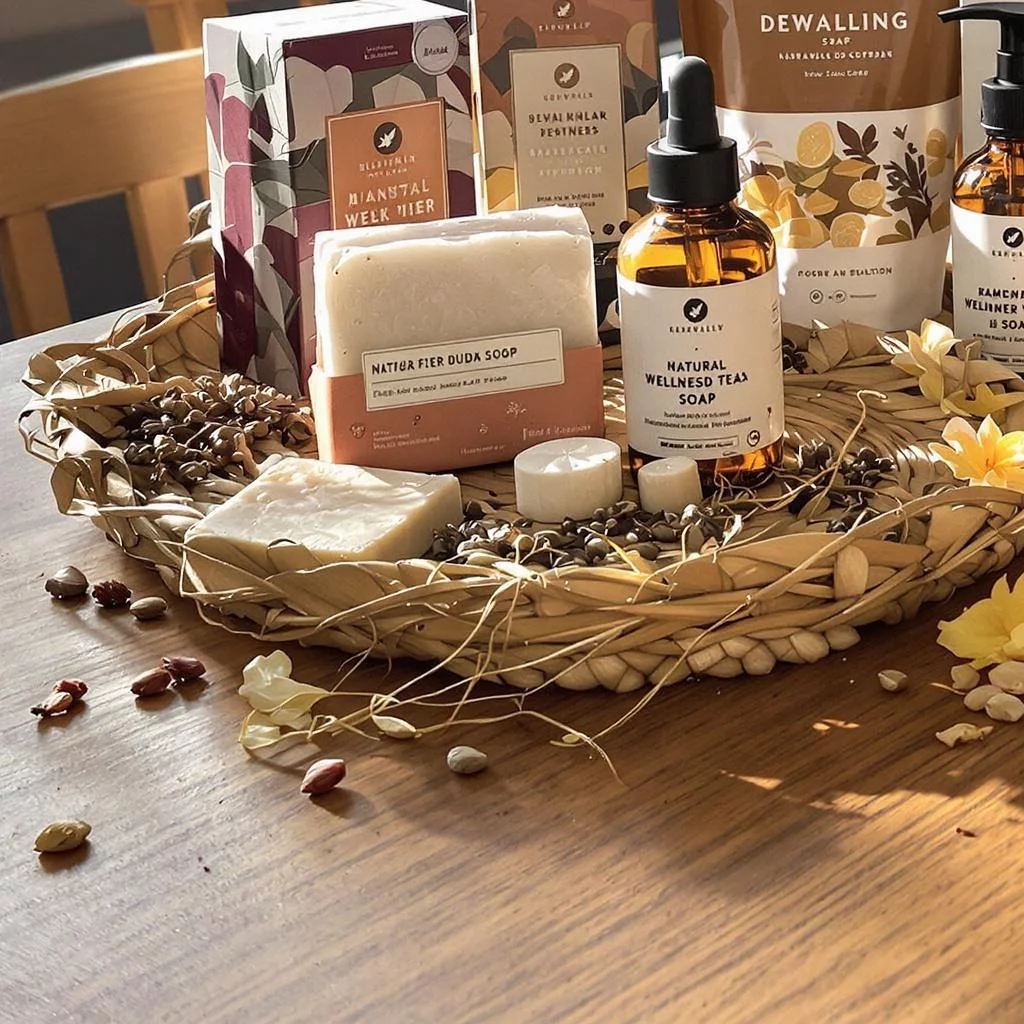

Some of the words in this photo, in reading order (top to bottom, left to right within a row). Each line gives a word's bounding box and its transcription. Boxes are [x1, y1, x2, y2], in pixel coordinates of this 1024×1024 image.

[760, 11, 909, 33] DEWALLING
[667, 359, 727, 373] NATURAL
[679, 392, 716, 405] SOAP
